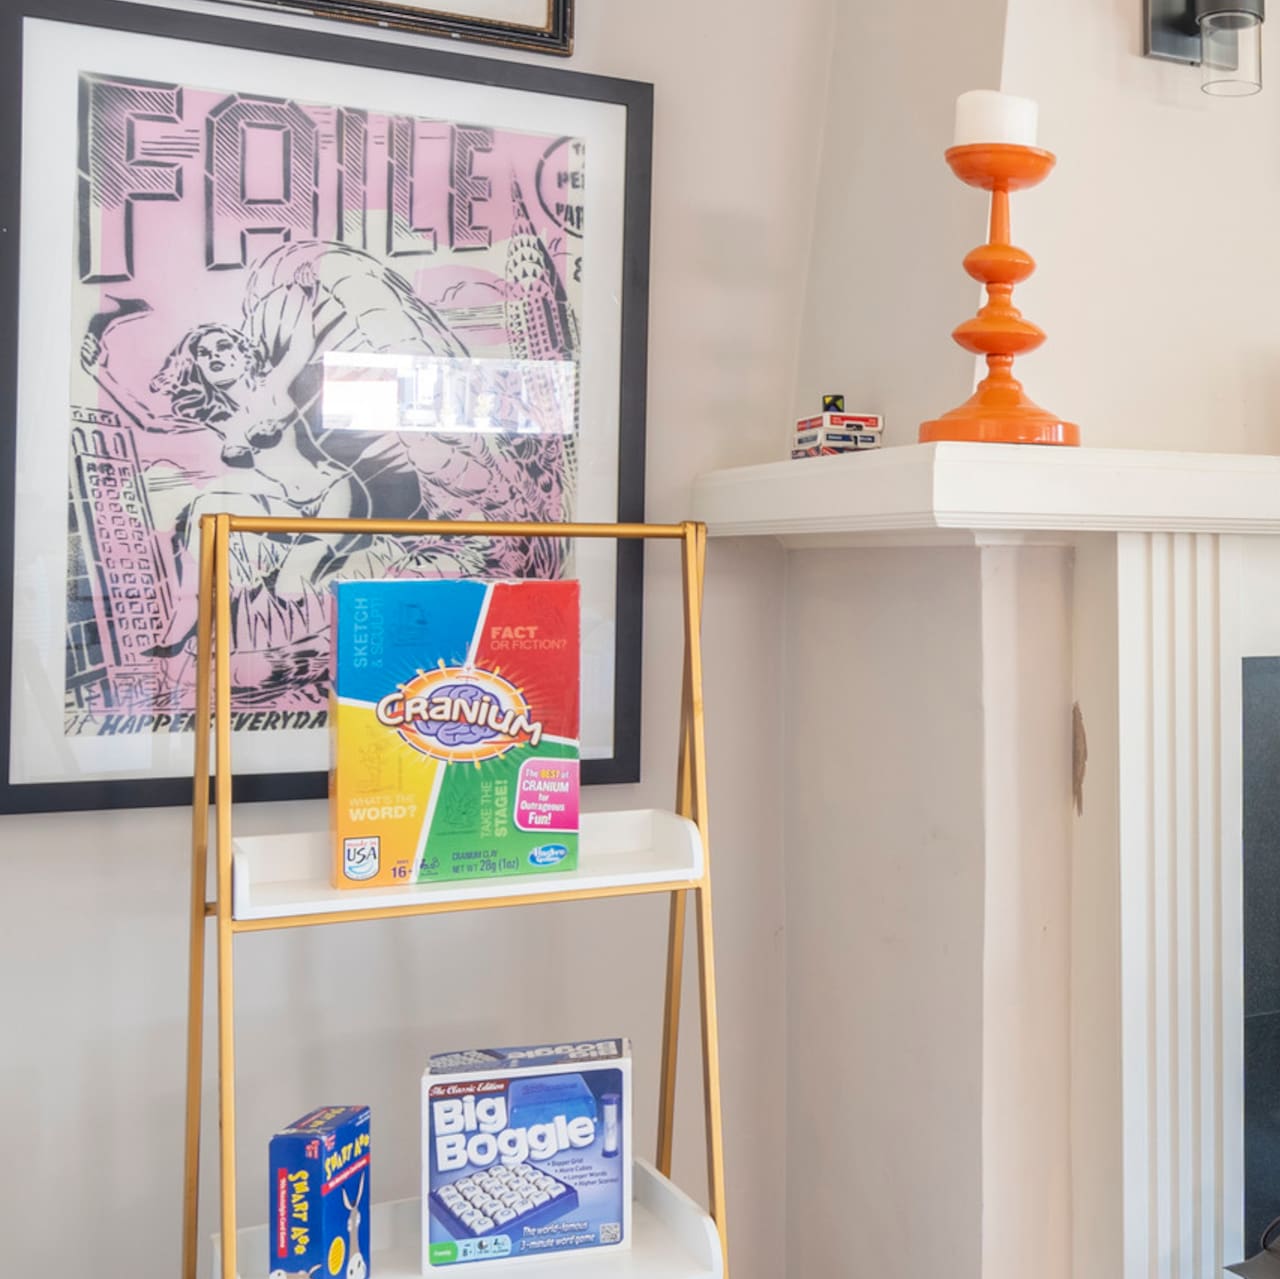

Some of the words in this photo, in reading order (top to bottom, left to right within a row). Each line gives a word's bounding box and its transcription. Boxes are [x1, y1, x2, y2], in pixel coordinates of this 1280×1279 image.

[76, 70, 495, 284] FAILE
[353, 597, 369, 669] SKETCH
[490, 625, 538, 639] FACT
[490, 640, 510, 651] OR
[511, 638, 567, 650] FICTION?
[522, 780, 570, 793] CRANIUM
[349, 805, 417, 822] WORD?
[494, 779, 508, 838] STAGE!
[528, 812, 552, 825] Fun!
[347, 846, 377, 864] USA
[433, 1095, 508, 1136] Big
[436, 1114, 595, 1172] Boggle
[287, 1170, 310, 1223] SMART
